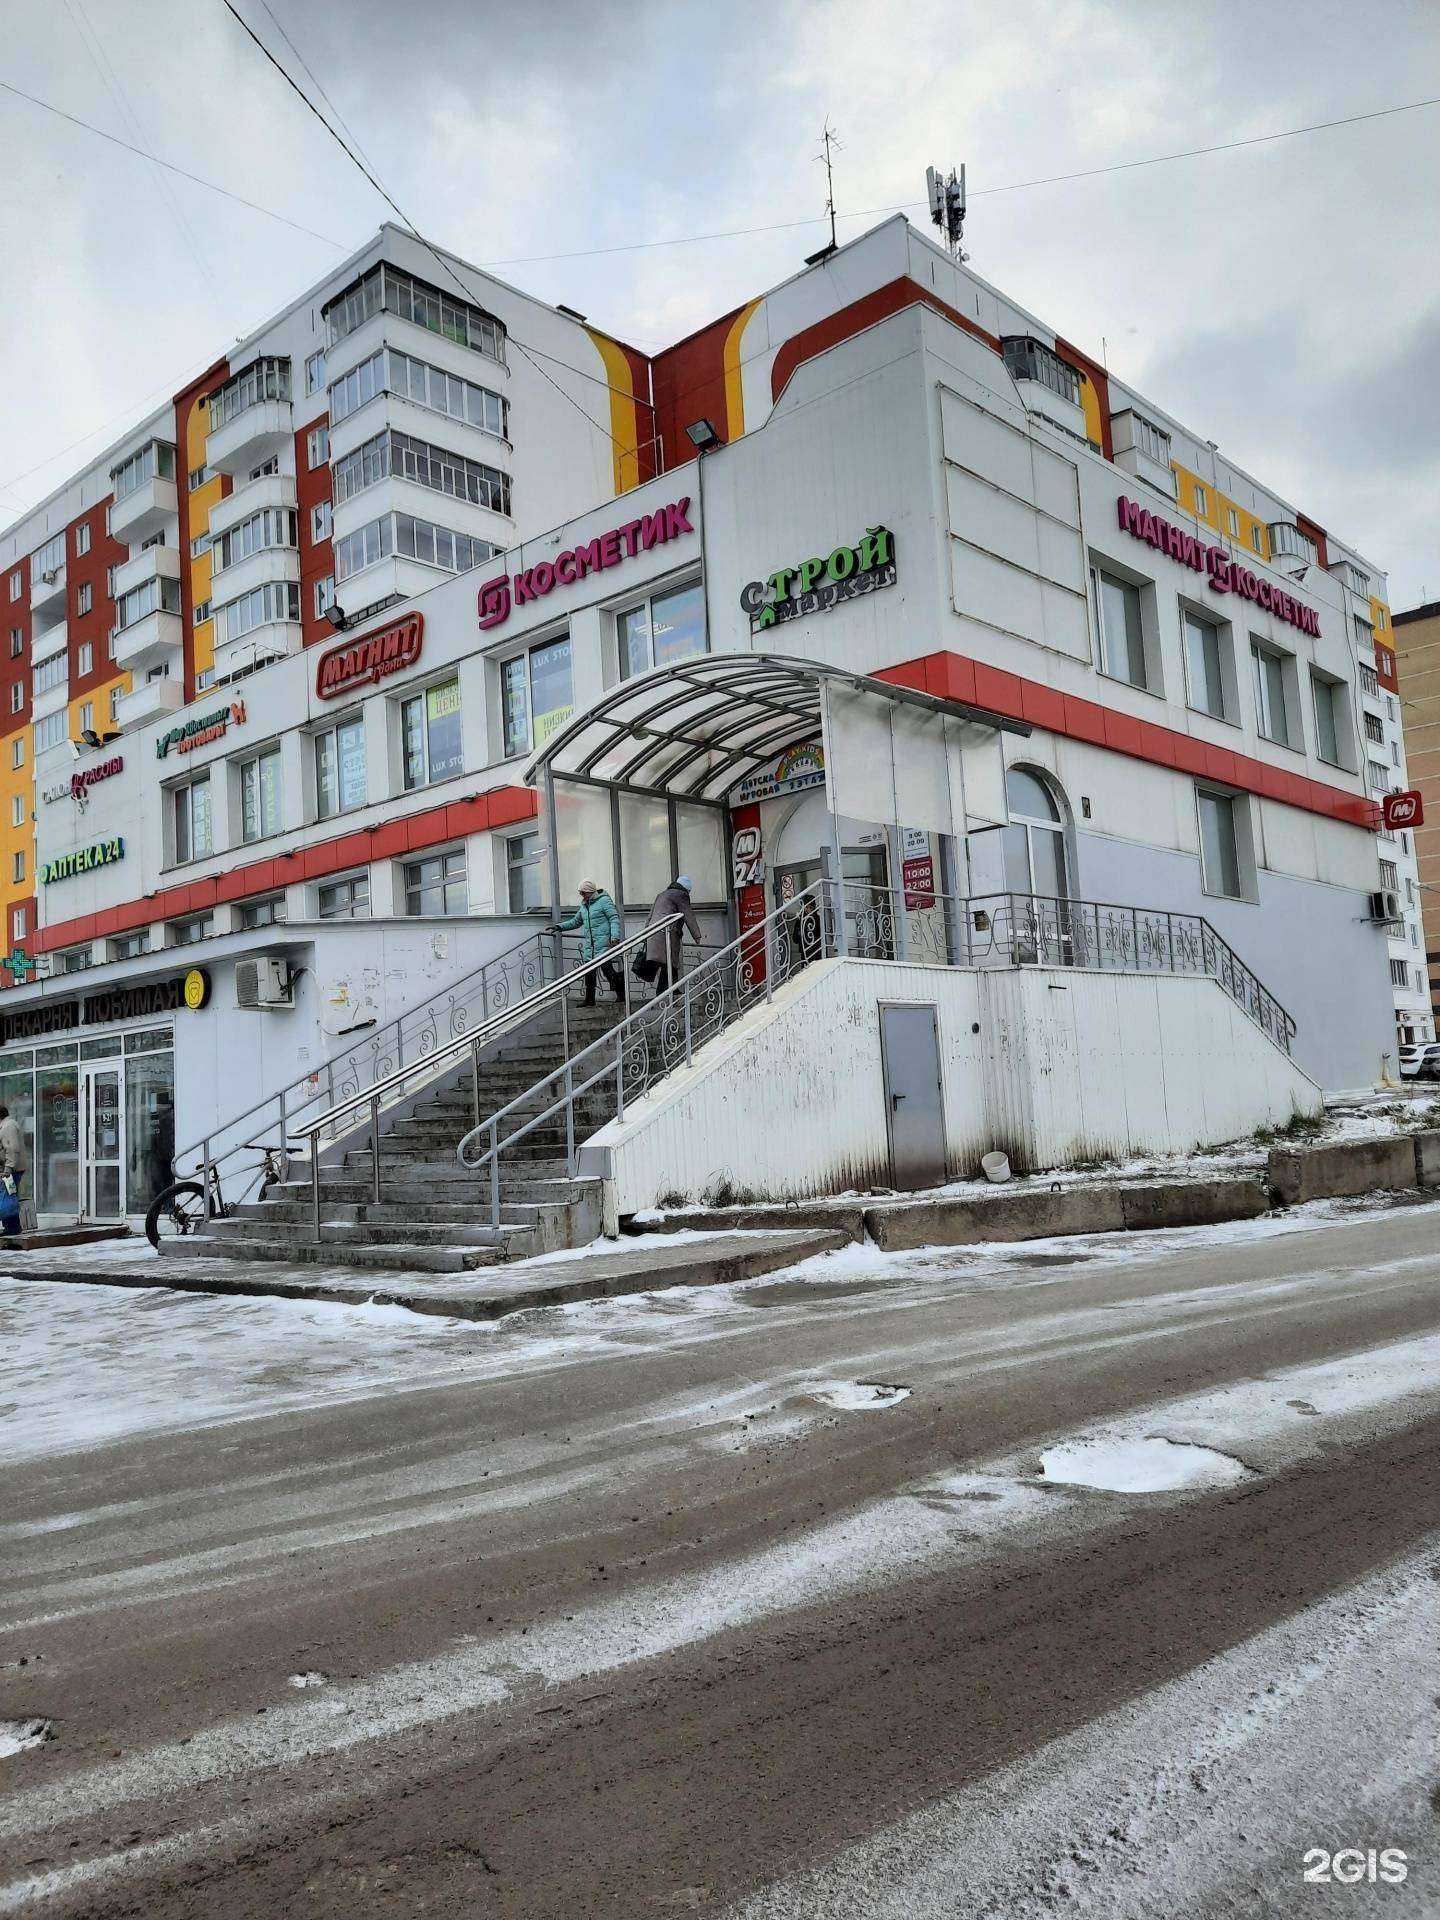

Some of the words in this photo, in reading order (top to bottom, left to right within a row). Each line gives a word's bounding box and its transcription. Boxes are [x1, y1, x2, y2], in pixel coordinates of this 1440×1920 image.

[514, 497, 695, 606] КОСМЕТИК
[739, 525, 895, 614] СТРОЙ
[1117, 495, 1207, 573] МАГНИТ
[1231, 562, 1323, 638] КОСМЕТИК
[321, 623, 417, 687] МАГНИТ
[533, 654, 549, 669] LUX
[432, 759, 447, 773] LUX
[48, 843, 106, 883] АПТЕКА
[105, 838, 124, 863] 24
[734, 859, 765, 888] 24
[3, 1002, 73, 1040] ПЕКАРНЯ
